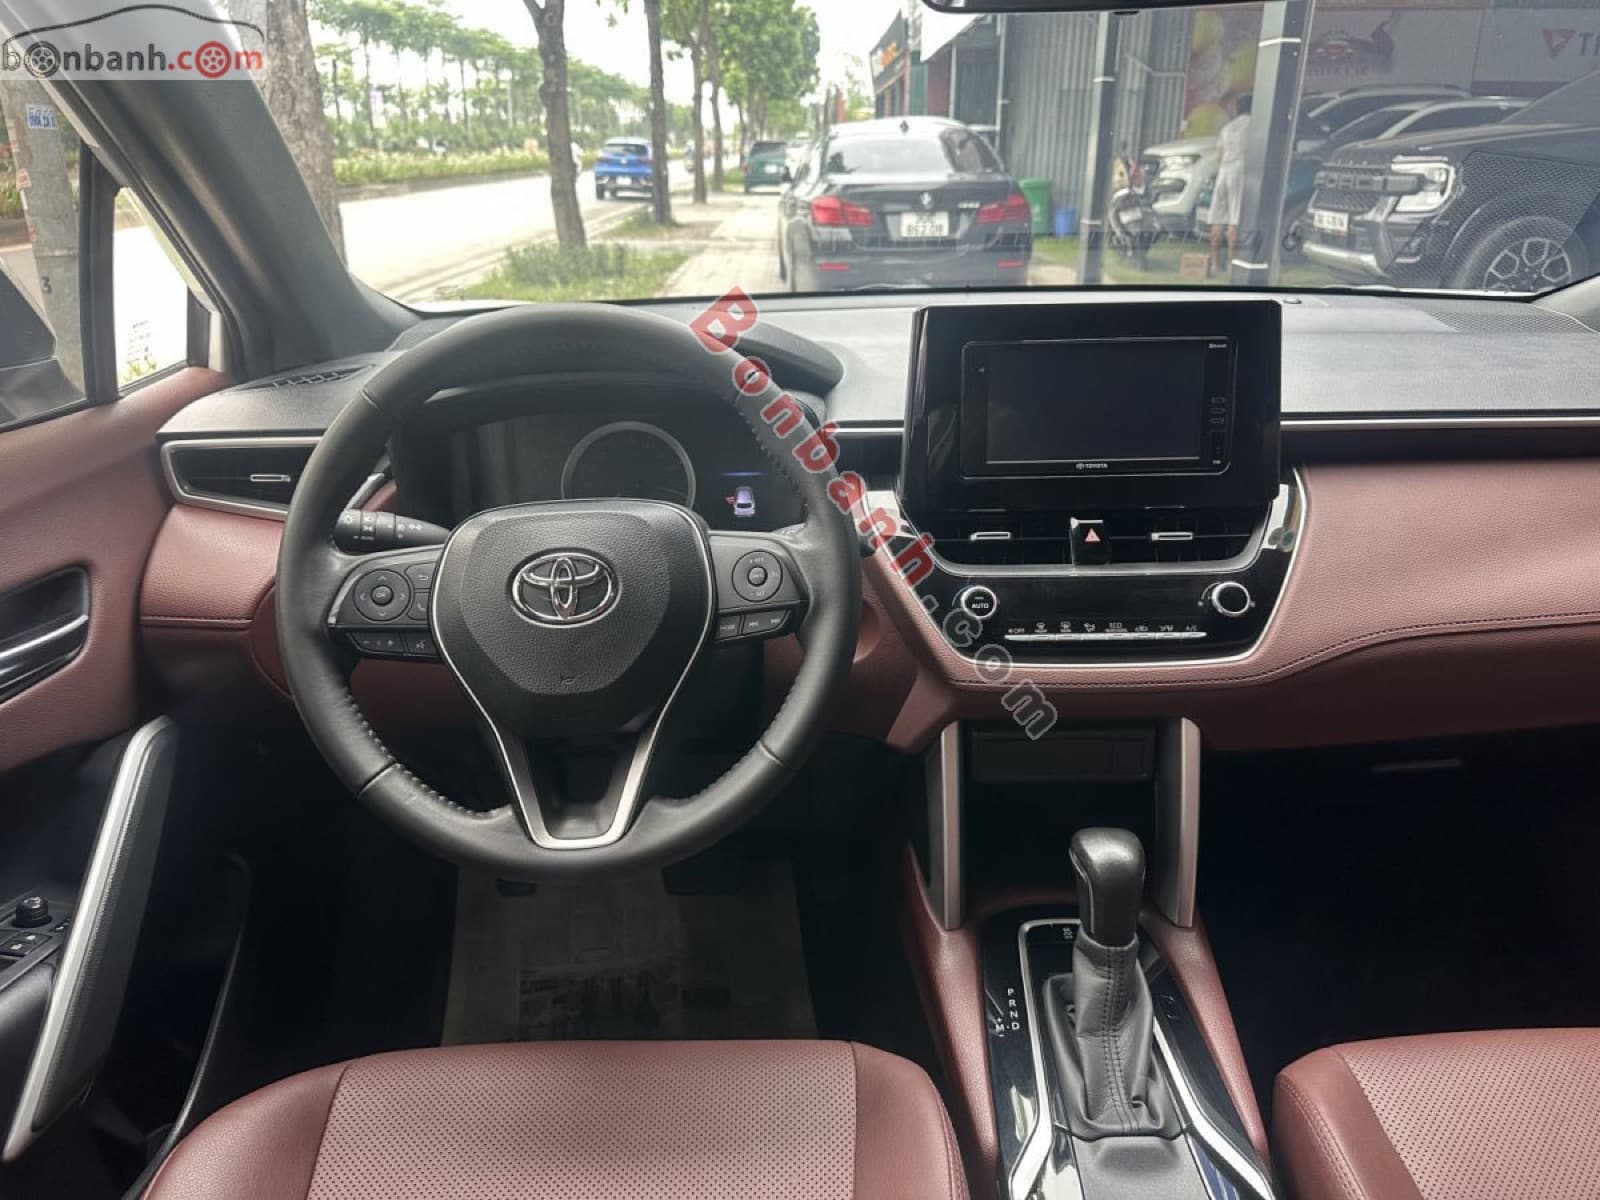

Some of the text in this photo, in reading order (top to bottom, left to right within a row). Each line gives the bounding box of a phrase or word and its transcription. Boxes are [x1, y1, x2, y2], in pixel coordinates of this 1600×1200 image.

[42, 276, 52, 294] 3
[1007, 988, 1014, 996] P
[1008, 999, 1017, 1007] R
[1010, 1010, 1018, 1018] N
[995, 1022, 1020, 1032] M D
